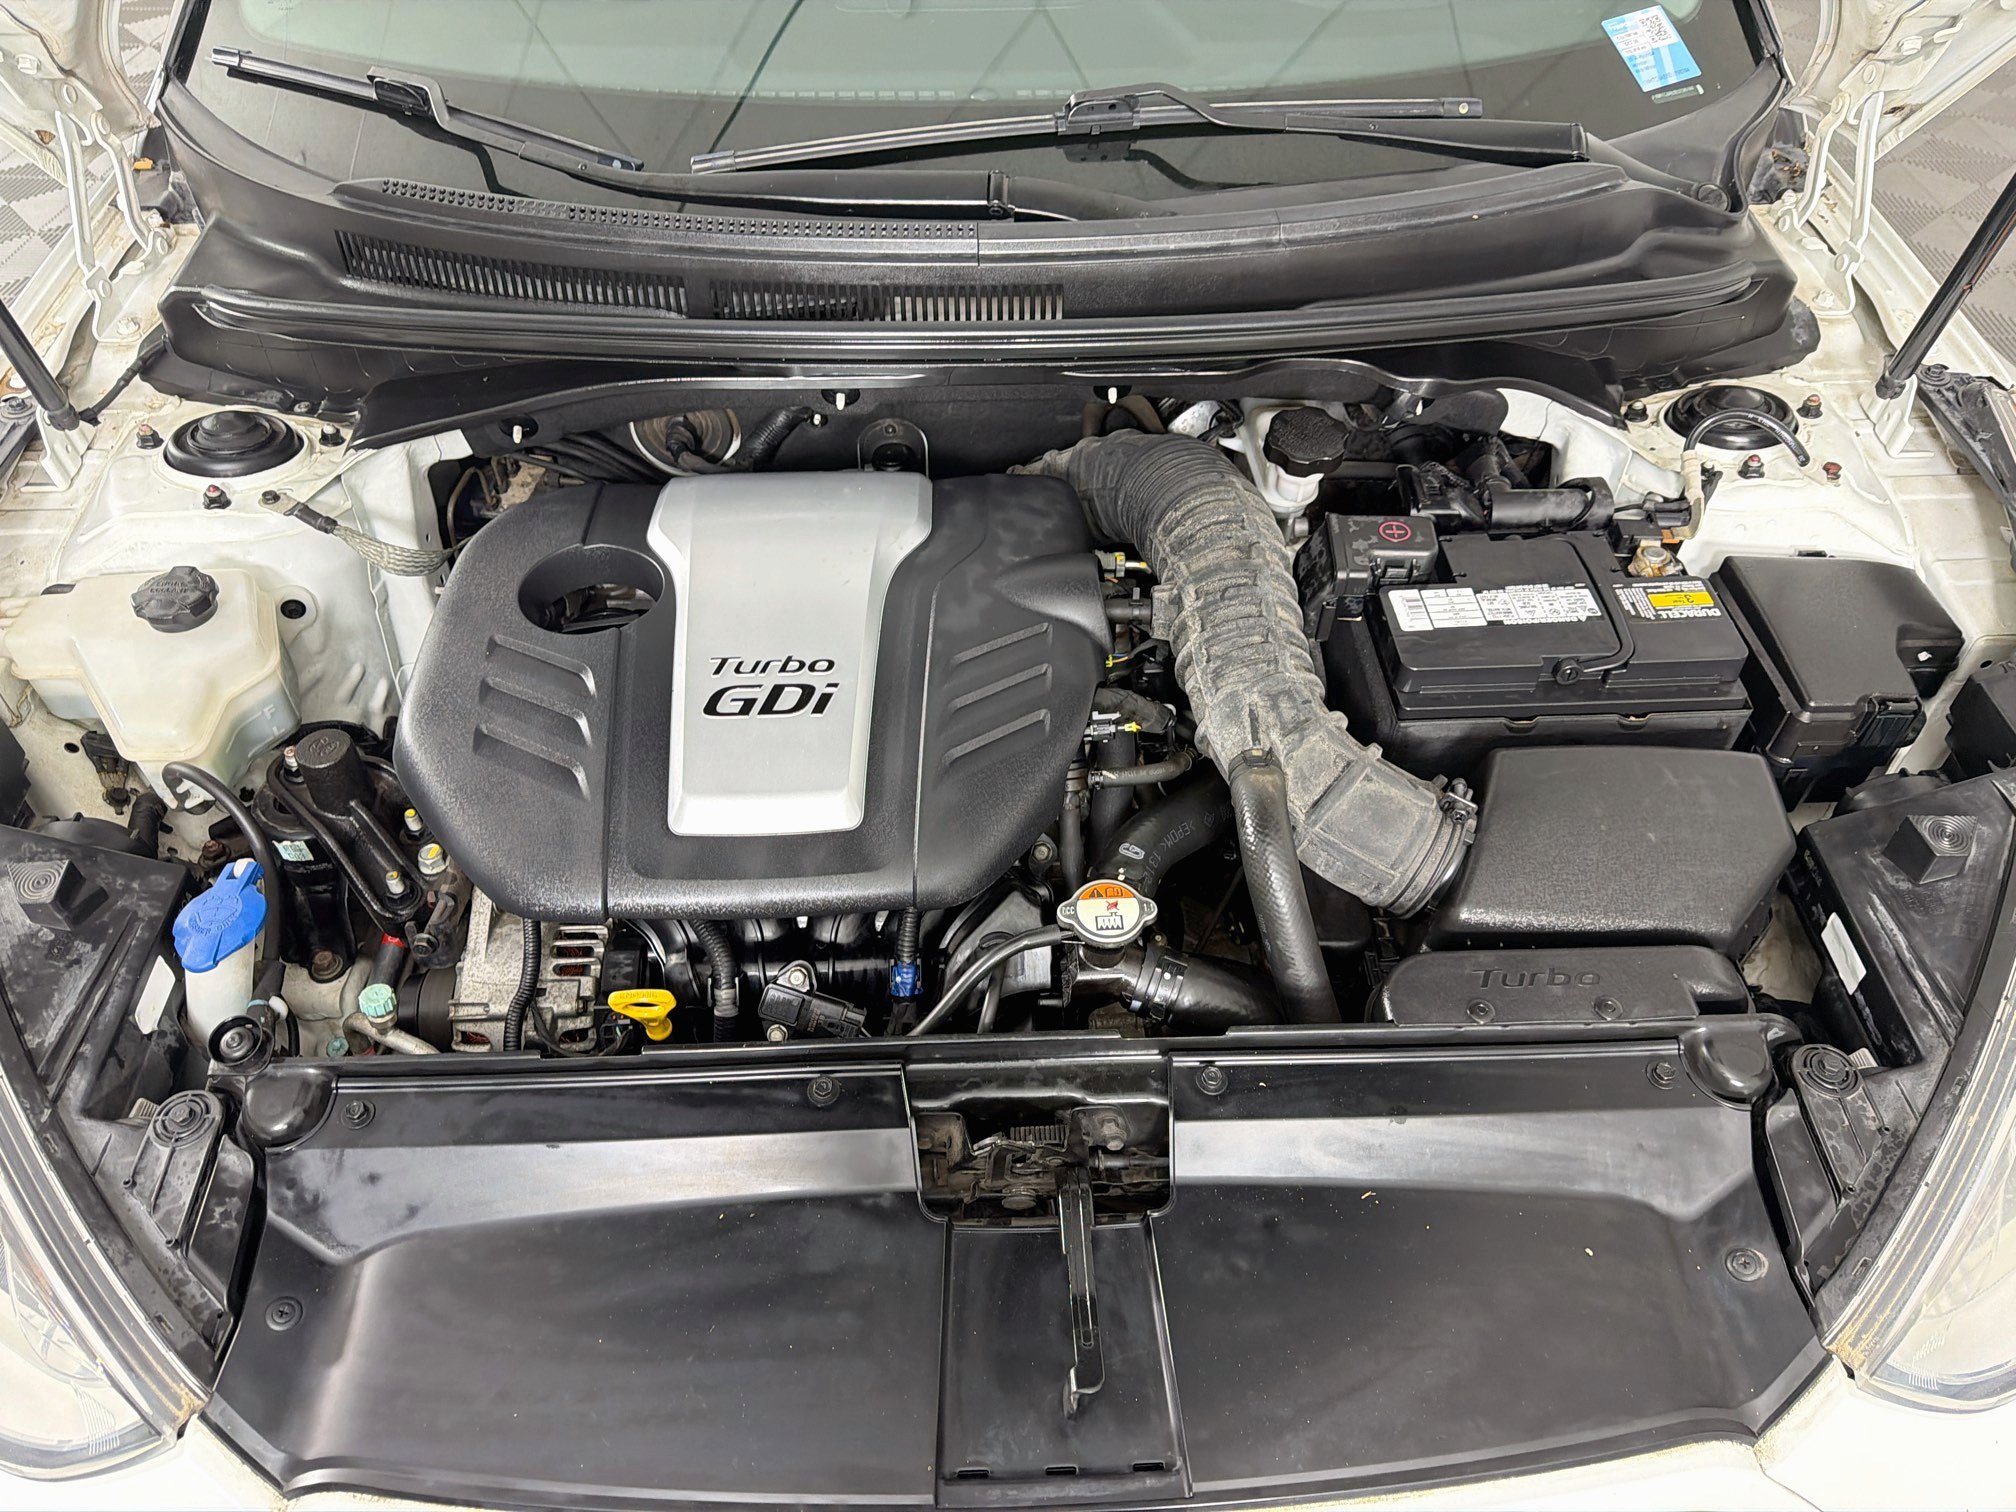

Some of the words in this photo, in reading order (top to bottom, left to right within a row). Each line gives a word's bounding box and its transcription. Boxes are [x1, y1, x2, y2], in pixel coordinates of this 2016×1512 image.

[1657, 607, 1722, 619] DURACELL
[709, 655, 836, 676] Turbo
[702, 682, 840, 717] GDi
[1471, 967, 1602, 989] Turbo
